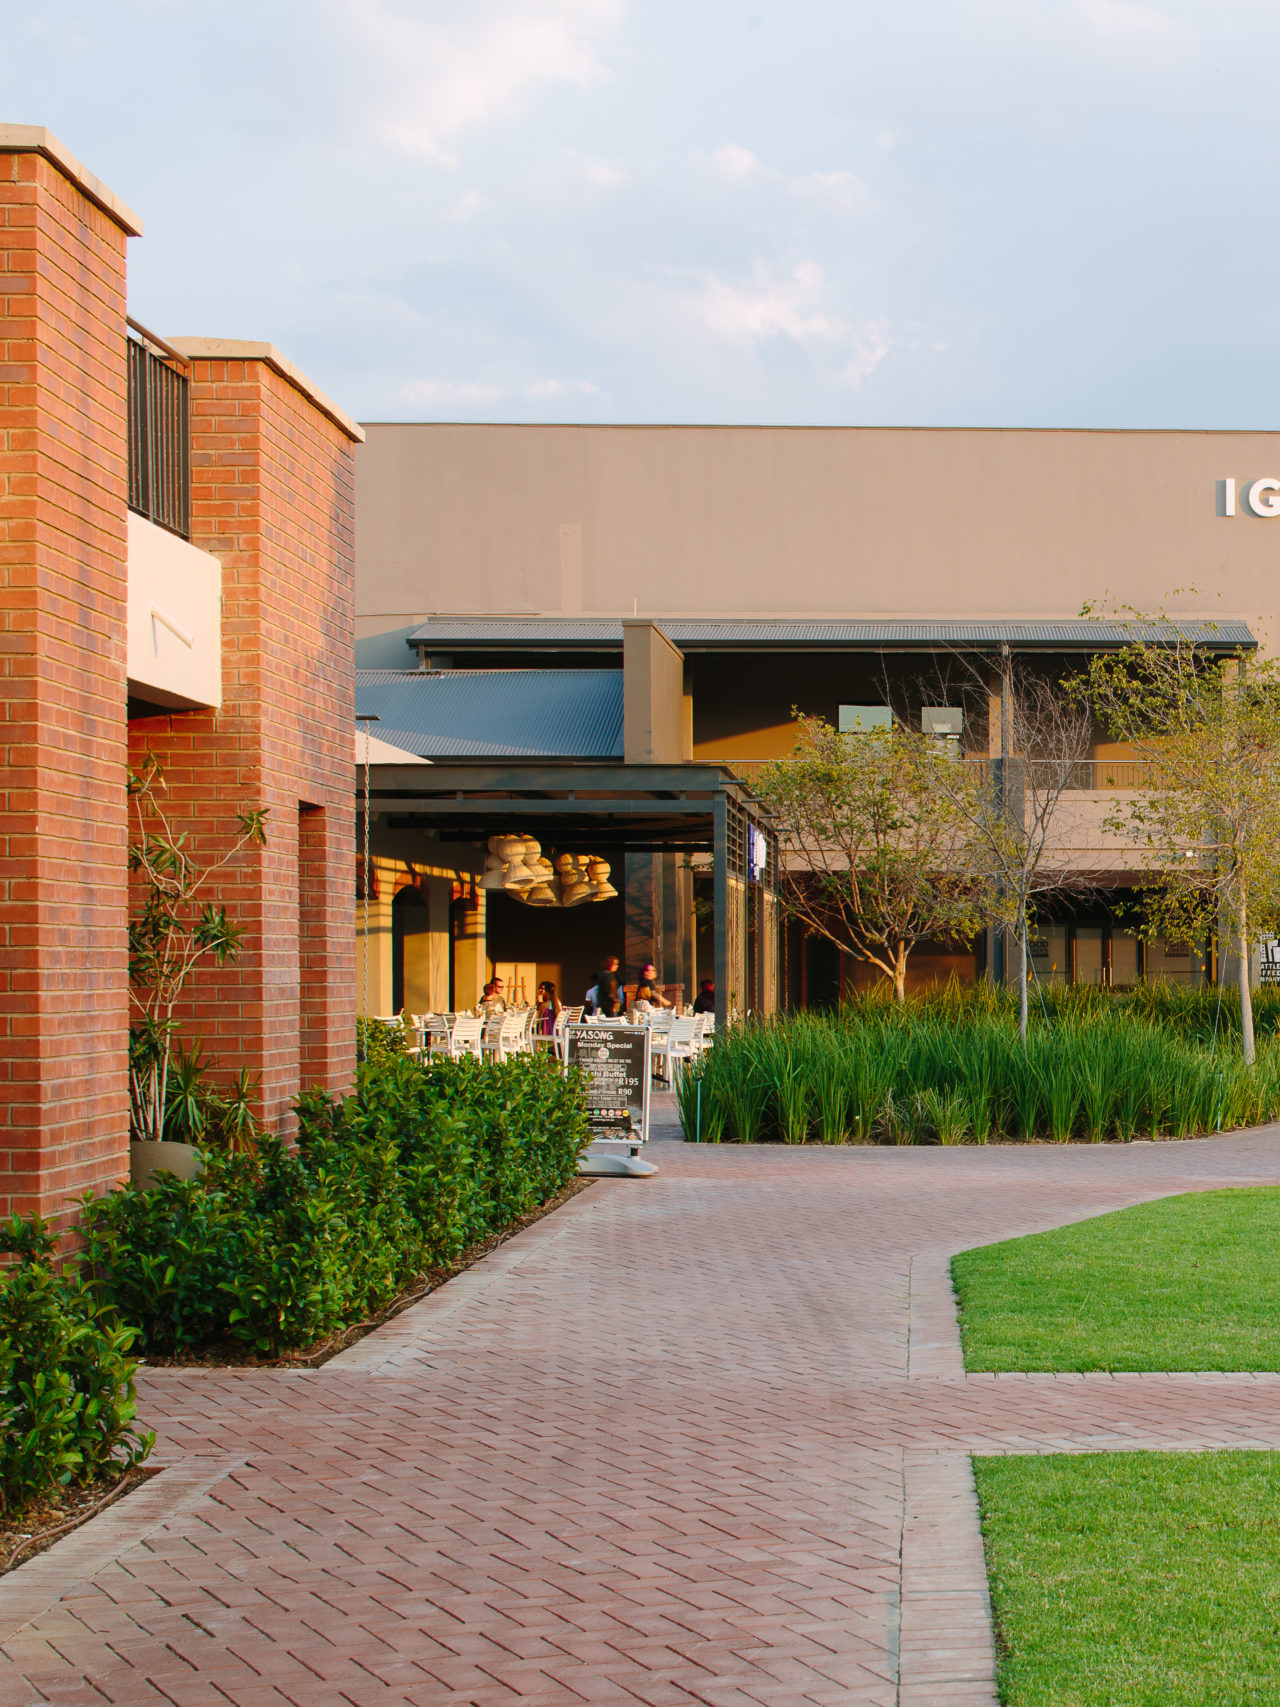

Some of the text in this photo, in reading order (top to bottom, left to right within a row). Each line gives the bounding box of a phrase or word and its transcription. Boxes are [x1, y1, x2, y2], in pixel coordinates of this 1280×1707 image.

[576, 1030, 614, 1040] YASONG
[577, 1041, 605, 1049] Monday
[618, 1077, 639, 1086] R195
[618, 1088, 633, 1096] R90
